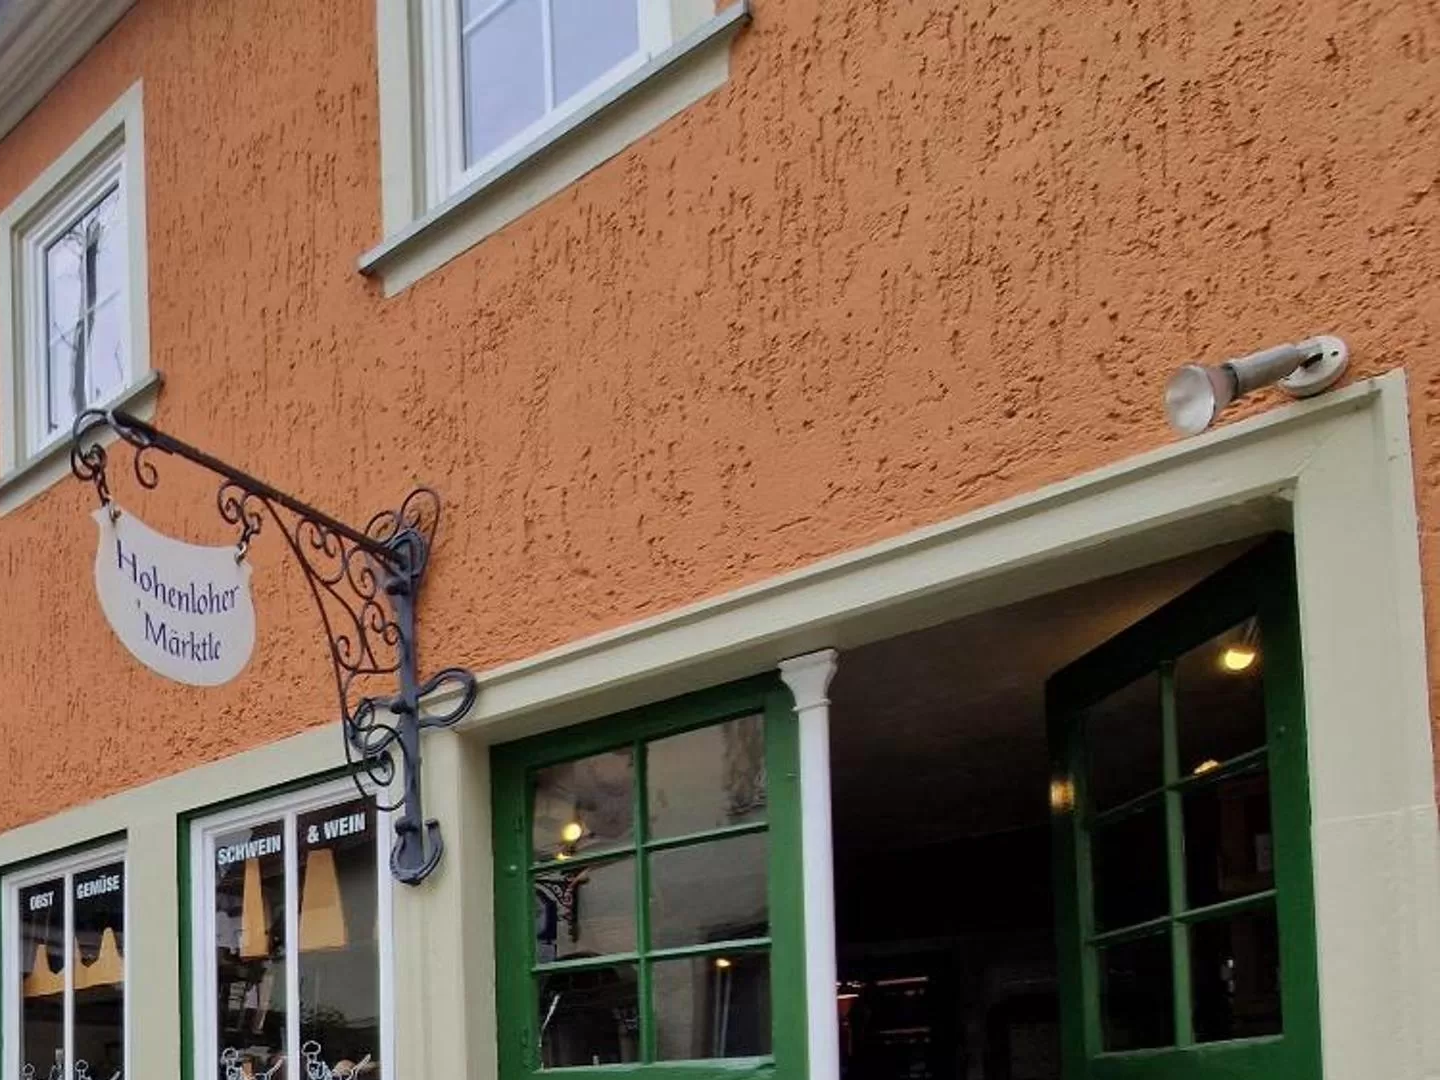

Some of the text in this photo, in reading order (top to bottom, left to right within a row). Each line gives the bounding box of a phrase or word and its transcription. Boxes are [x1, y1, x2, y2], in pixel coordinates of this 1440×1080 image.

[116, 539, 240, 615] Hohenloher
[144, 611, 222, 663] Märktle
[217, 812, 366, 865] SCHWEIN & WEIN
[30, 874, 120, 911] OBST GEMÜSE
